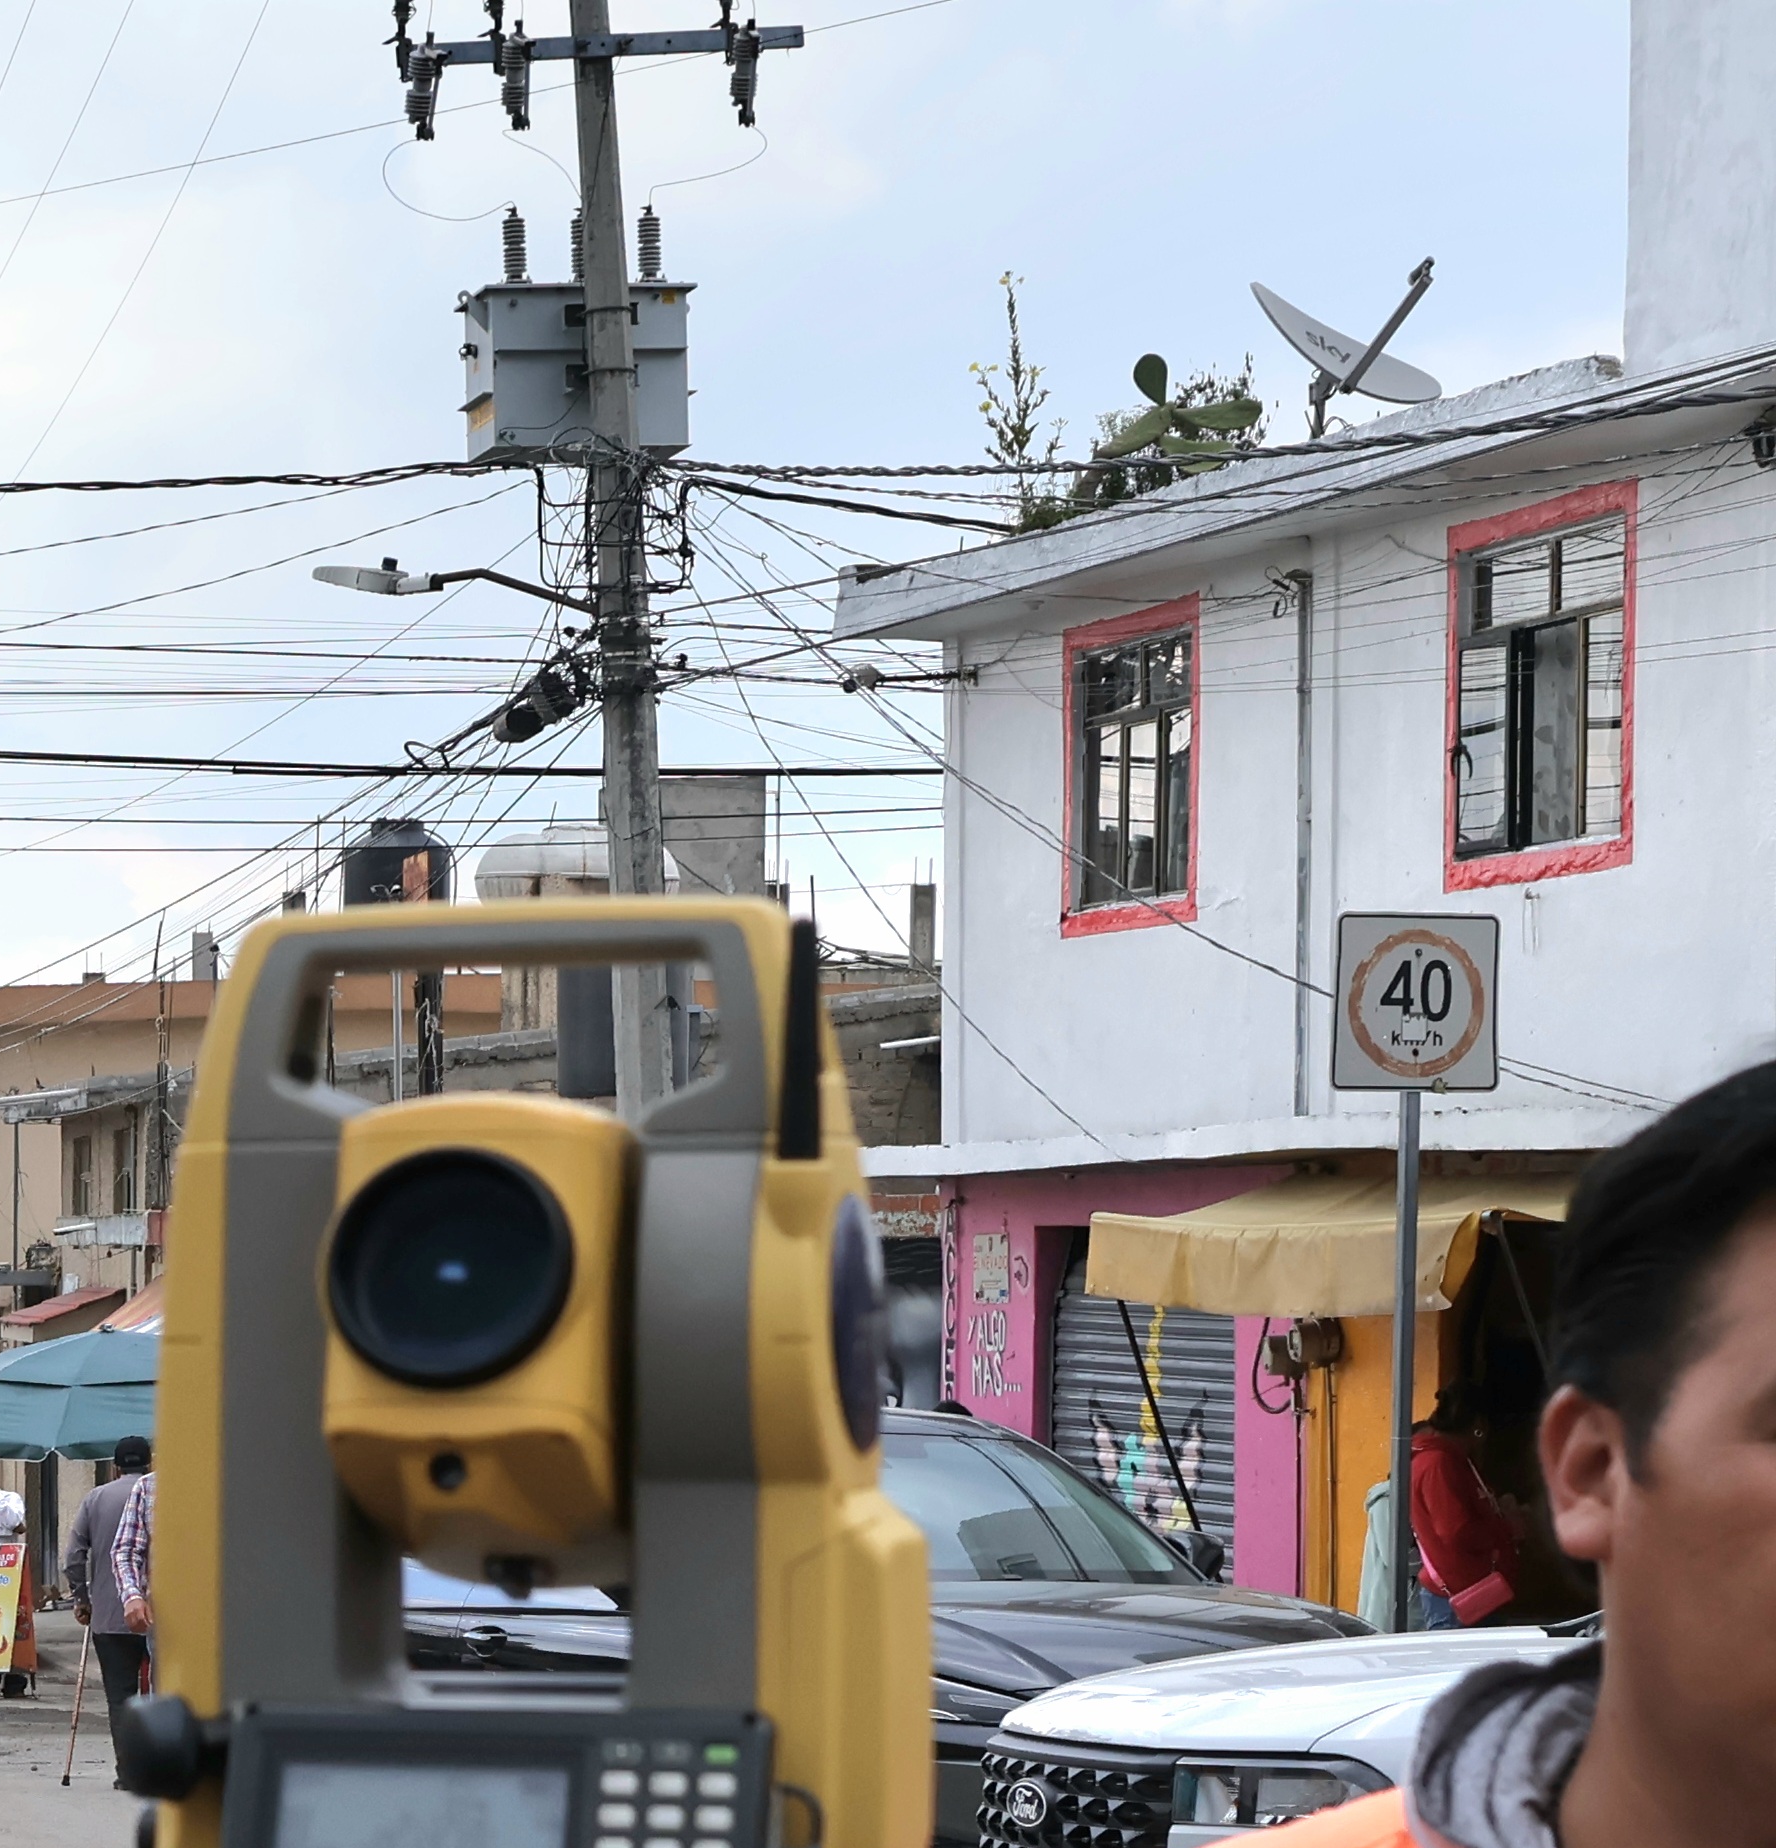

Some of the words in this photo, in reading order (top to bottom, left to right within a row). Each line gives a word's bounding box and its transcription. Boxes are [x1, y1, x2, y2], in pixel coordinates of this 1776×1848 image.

[1380, 960, 1452, 1022] 40
[977, 1310, 1007, 1352] ALGO
[1012, 1787, 1039, 1821] Ford
